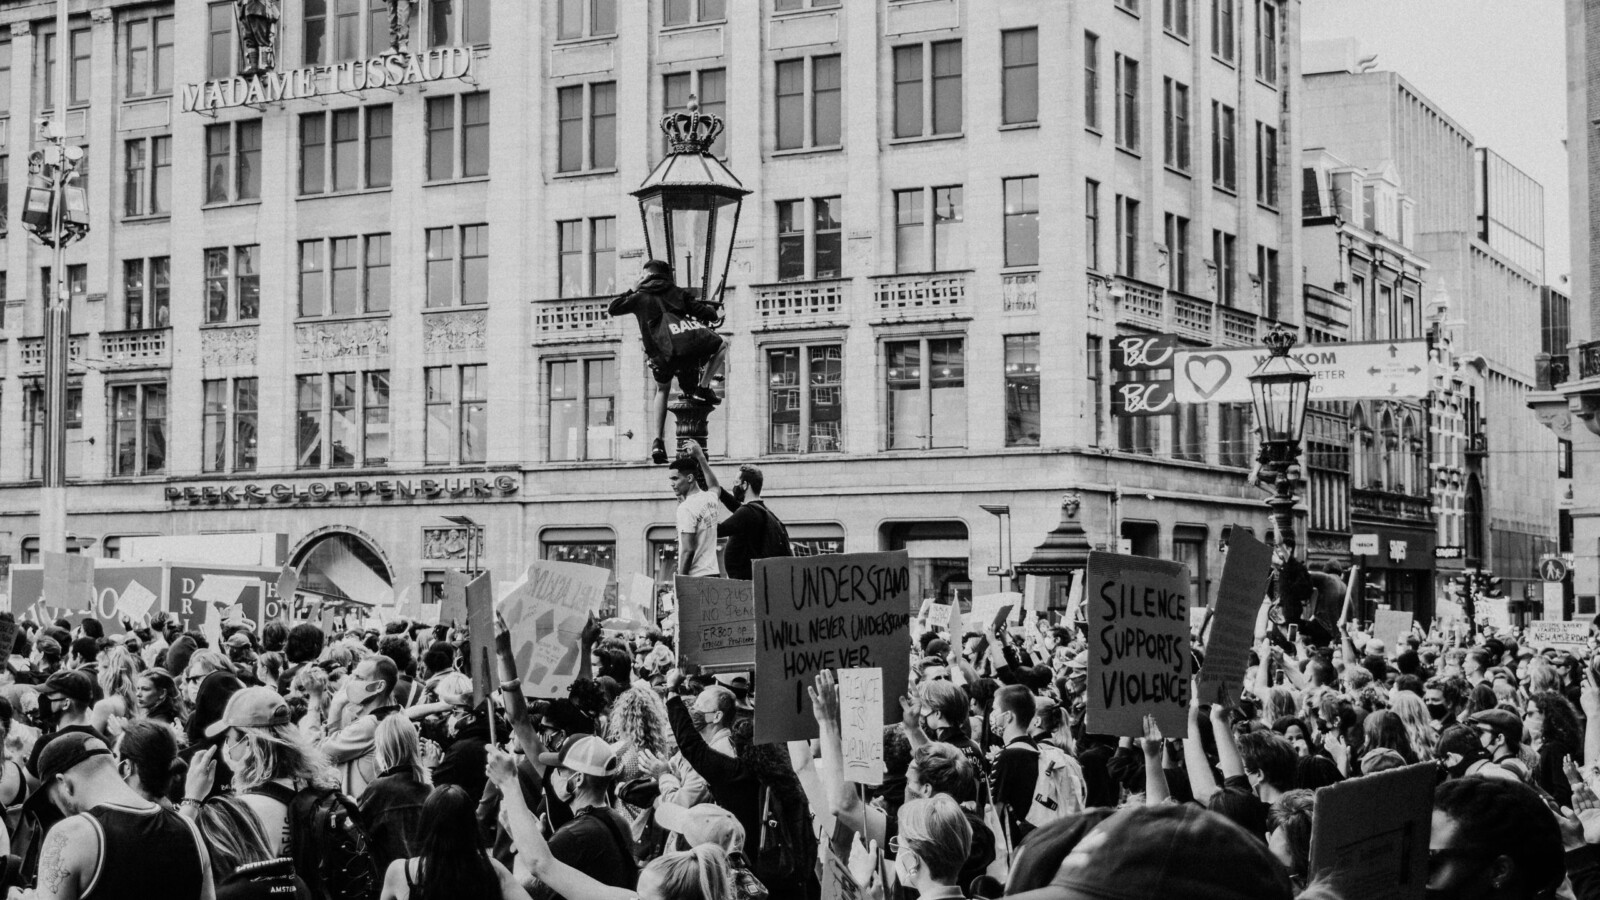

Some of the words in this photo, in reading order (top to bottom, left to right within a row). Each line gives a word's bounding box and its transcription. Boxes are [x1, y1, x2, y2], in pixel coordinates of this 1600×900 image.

[181, 67, 316, 111] MADAME
[1118, 337, 1173, 367] P&C
[1253, 352, 1337, 366] WKOM
[1119, 383, 1174, 413] P&C
[164, 485, 238, 502] PEEK
[270, 475, 518, 500] CLOPPENBURG
[763, 566, 769, 615] I
[791, 564, 909, 611] UNDERSTAND
[1101, 580, 1186, 622] SILENCE
[703, 607, 720, 621] NO
[763, 620, 769, 651] I
[770, 619, 804, 651] WILL
[808, 616, 848, 643] NEVER
[851, 611, 910, 642] UNDERSTAND
[1535, 633, 1550, 642] NEW
[1552, 633, 1588, 643] AMSTERDAM
[1101, 624, 1183, 674] SUPPORTS
[797, 679, 803, 715] I
[842, 672, 880, 703] ILENCE
[1102, 670, 1187, 710] VIOLENCE
[850, 706, 865, 731] IS
